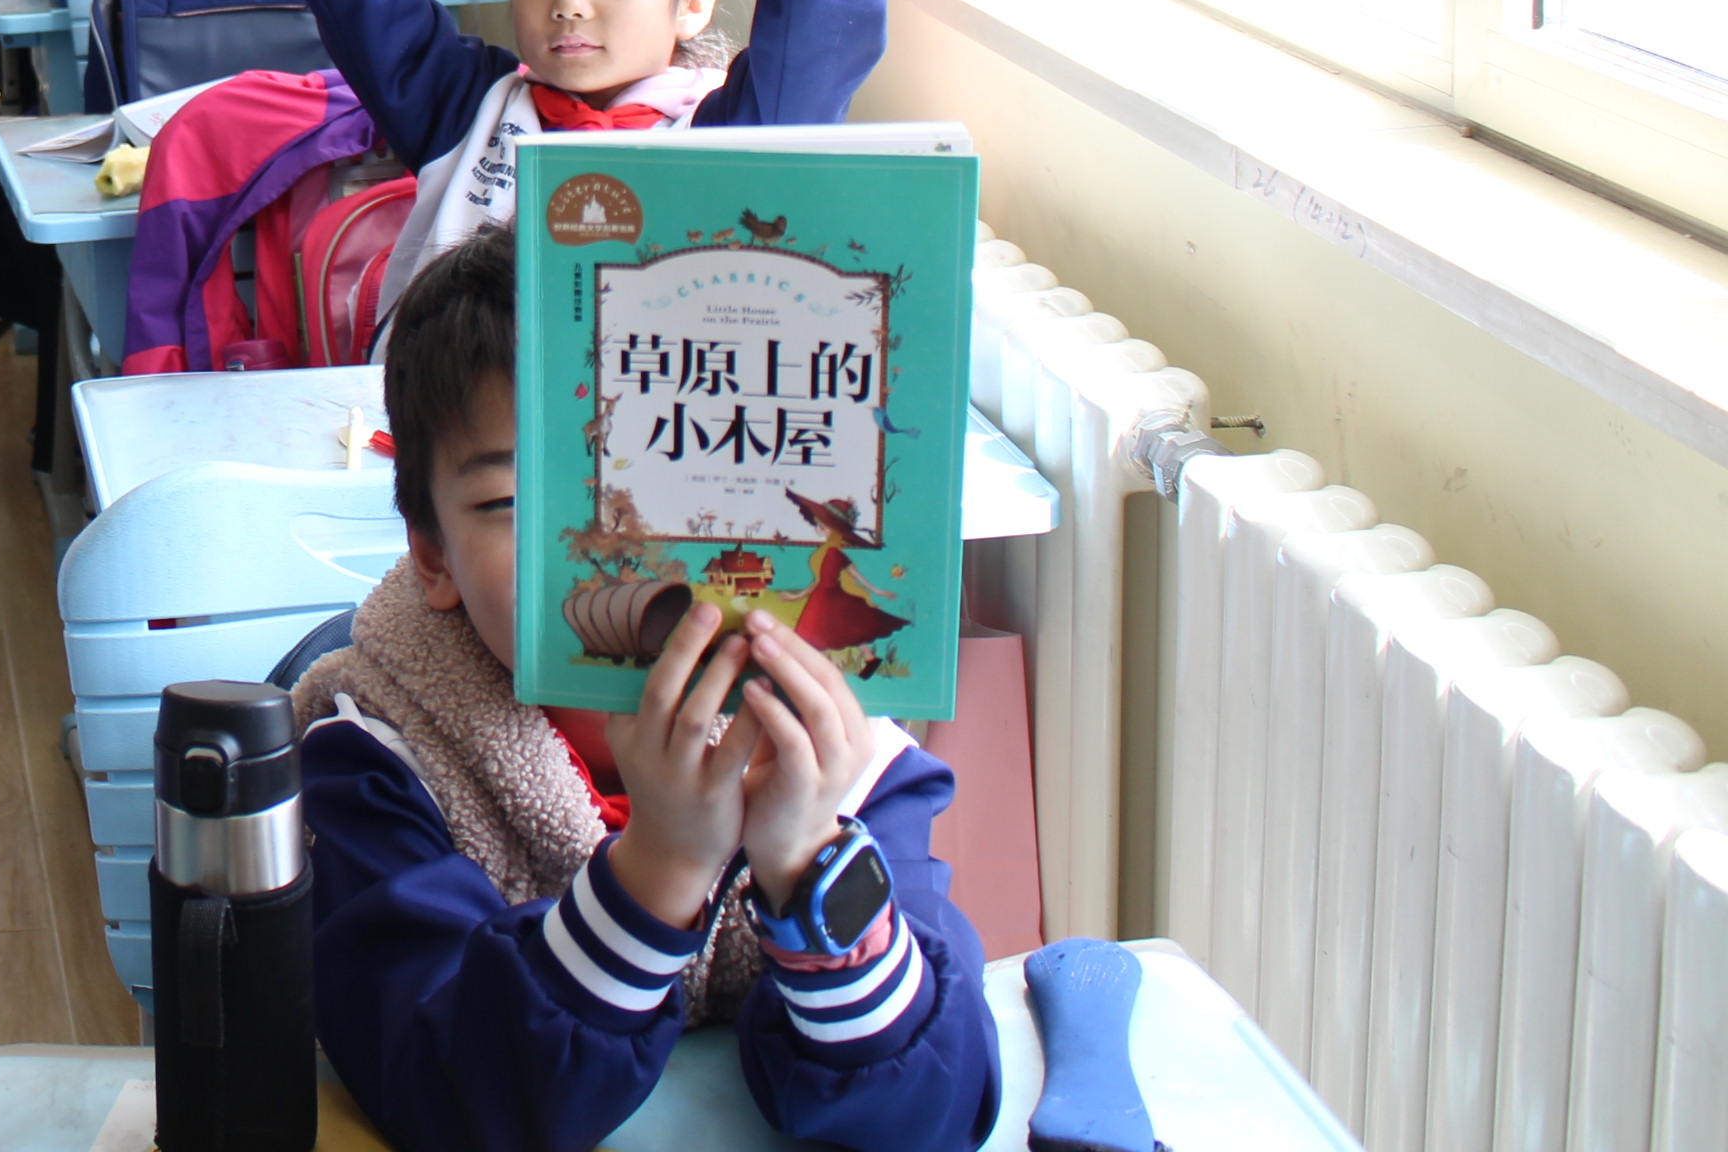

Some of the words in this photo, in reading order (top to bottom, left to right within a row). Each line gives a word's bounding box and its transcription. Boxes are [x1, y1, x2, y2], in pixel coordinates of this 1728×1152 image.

[553, 180, 633, 216] Literature
[677, 271, 806, 304] CLASSICS
[707, 304, 739, 314] Little
[742, 306, 778, 316] House
[721, 315, 739, 324] the
[742, 317, 781, 327] Prairie
[612, 333, 873, 404] 草原上的
[645, 402, 837, 468] 小木屋
